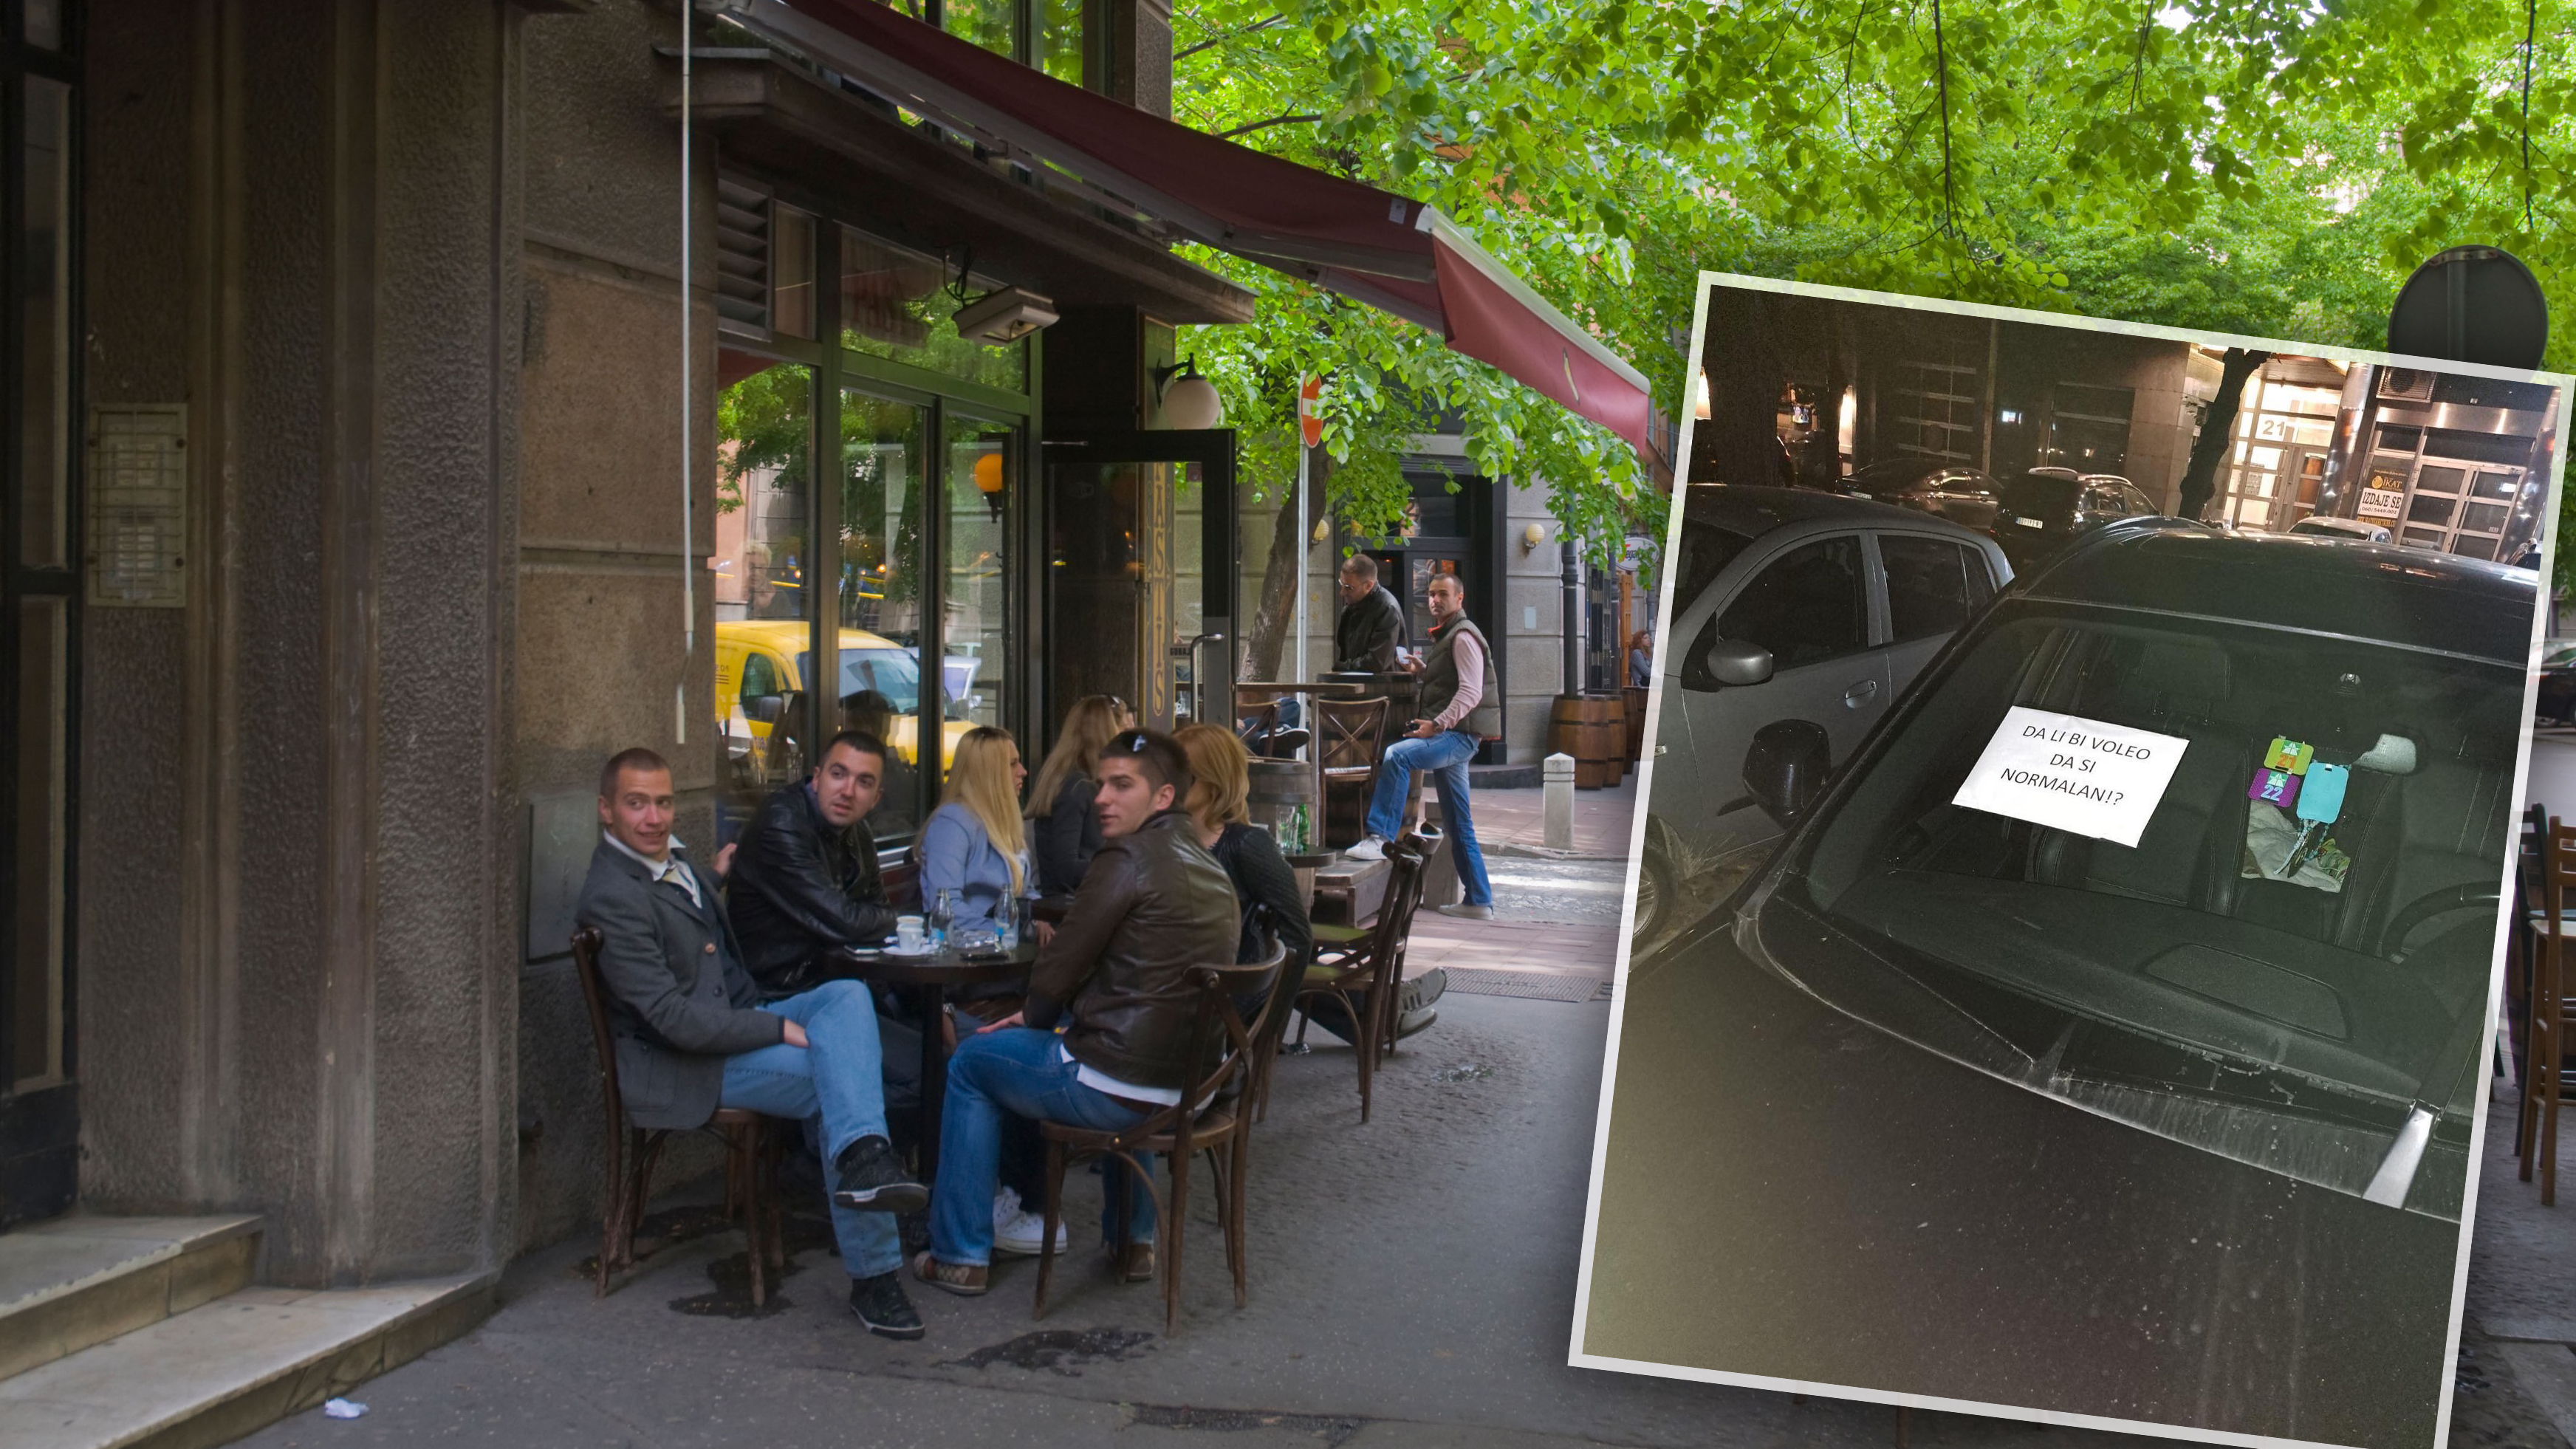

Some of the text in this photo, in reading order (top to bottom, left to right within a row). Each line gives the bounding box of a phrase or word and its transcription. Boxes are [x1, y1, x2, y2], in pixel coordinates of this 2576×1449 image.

[2263, 419, 2285, 436] 21
[2362, 492, 2402, 509] IZDAJE SE
[2022, 725, 2151, 760] DA LI BI VOLEO
[2049, 753, 2097, 773] DA SI
[2277, 754, 2297, 768] 21
[2000, 768, 2124, 805] NORMALAN!?
[2260, 784, 2284, 802] 22
